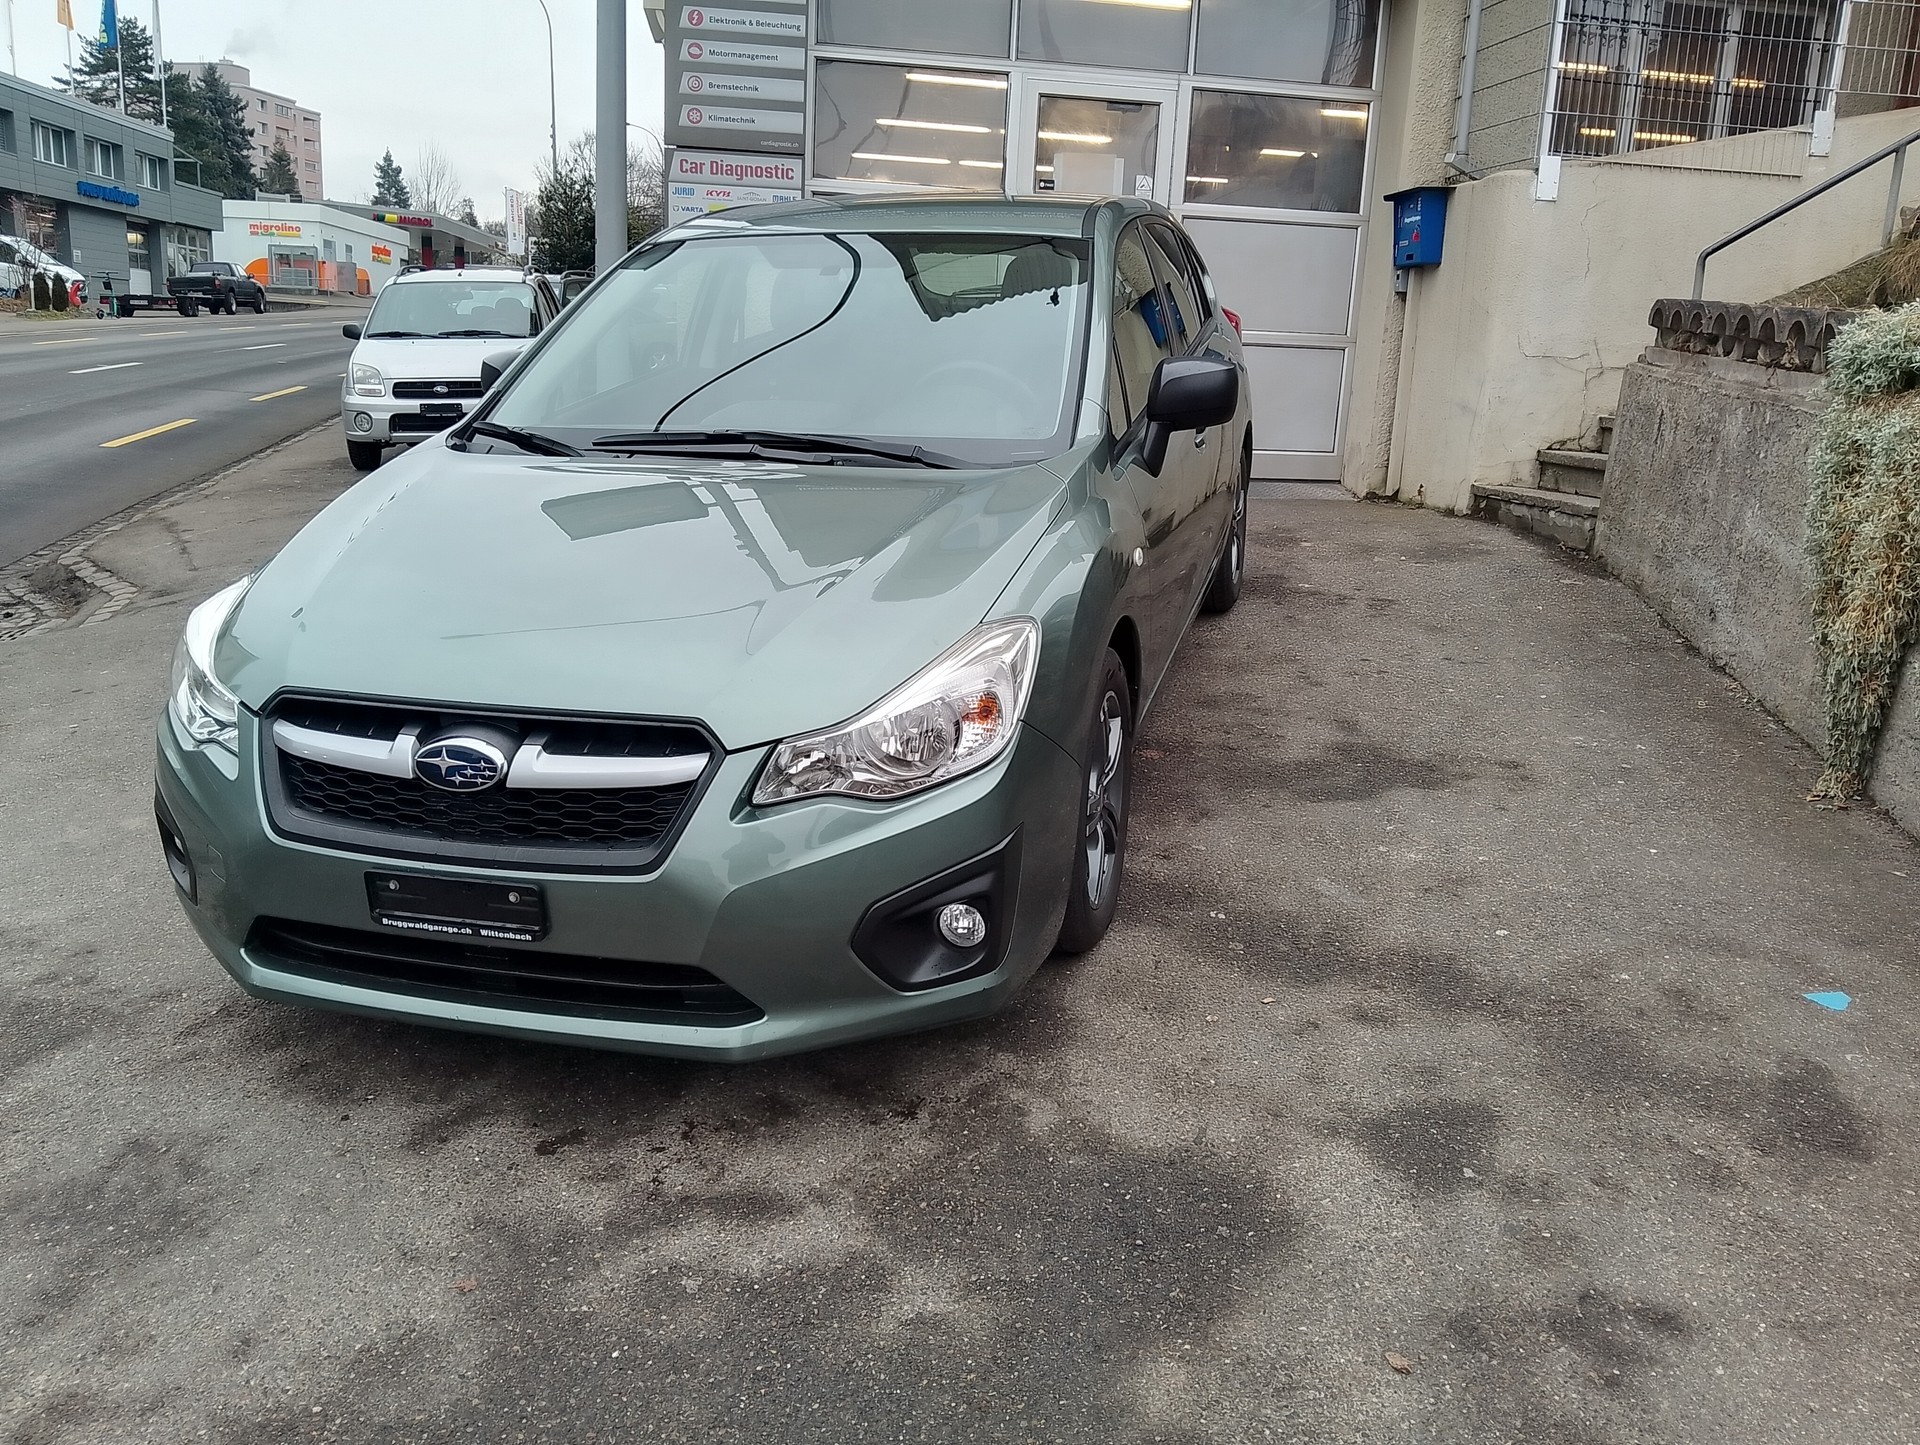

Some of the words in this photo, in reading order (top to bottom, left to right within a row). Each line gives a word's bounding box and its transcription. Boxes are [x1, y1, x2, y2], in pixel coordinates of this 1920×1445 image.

[709, 15, 747, 26] Elektronik
[748, 18, 754, 26] &
[755, 19, 802, 32] Beleuchtung
[708, 49, 779, 62] Motormanagement
[708, 81, 760, 93] Bremstechnik
[708, 114, 756, 125] Klimatechnik
[760, 139, 800, 148] cardiagnostic.ch
[679, 158, 706, 175] Car
[710, 159, 795, 181] Diagnostic
[672, 186, 695, 197] JURID
[680, 205, 704, 213] VARTA
[248, 221, 302, 233] migrolino
[399, 215, 434, 228] MIGROL
[382, 917, 473, 935] Bruggwaldgarage.ch
[479, 928, 532, 941] Wittenbach
